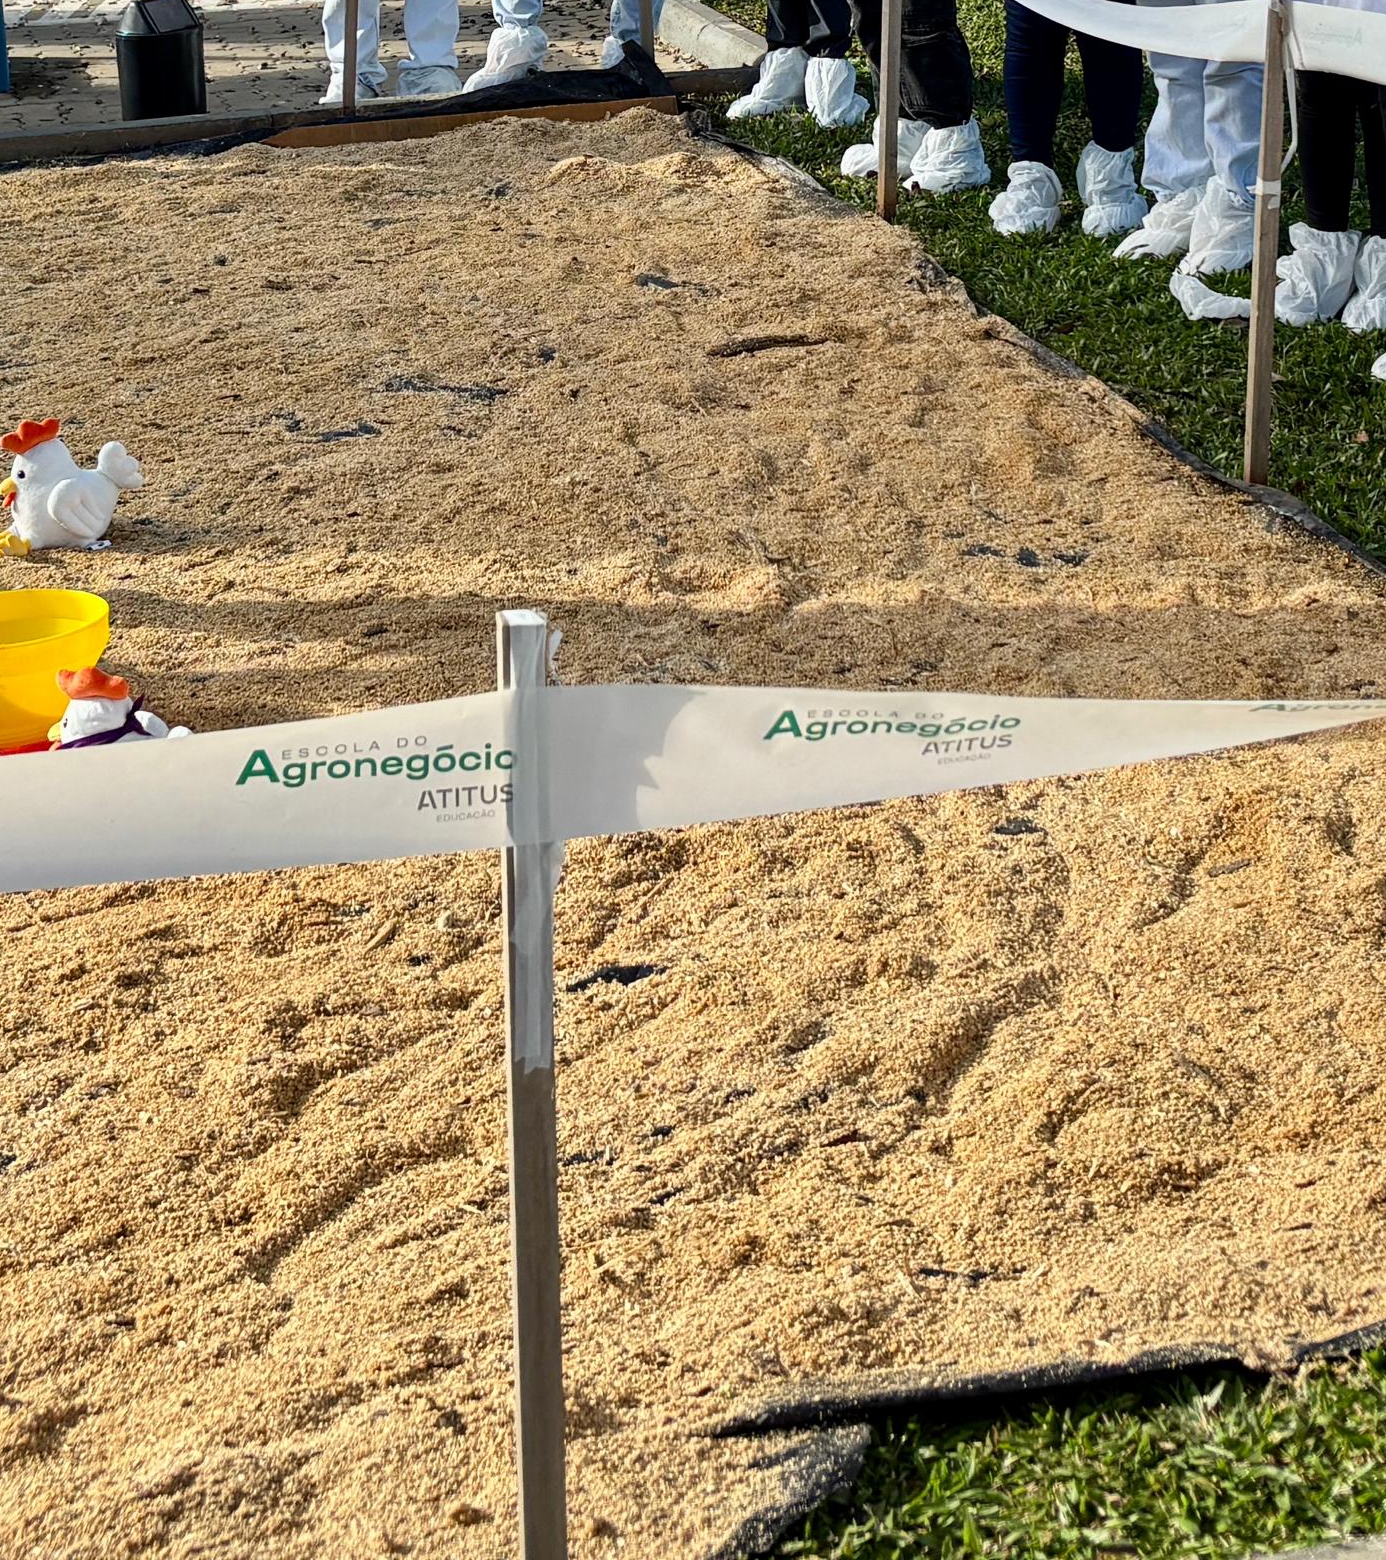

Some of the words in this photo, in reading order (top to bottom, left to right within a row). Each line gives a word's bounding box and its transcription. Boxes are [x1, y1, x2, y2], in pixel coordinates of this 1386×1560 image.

[763, 710, 1021, 741] Agronegócio
[281, 740, 381, 760] ESCOLA
[396, 735, 428, 748] DO
[921, 734, 1013, 756] ATITUS
[235, 742, 518, 788] Agronegócio
[417, 783, 514, 811] ATITUS
[435, 809, 496, 823] EDUCAÇÃO
